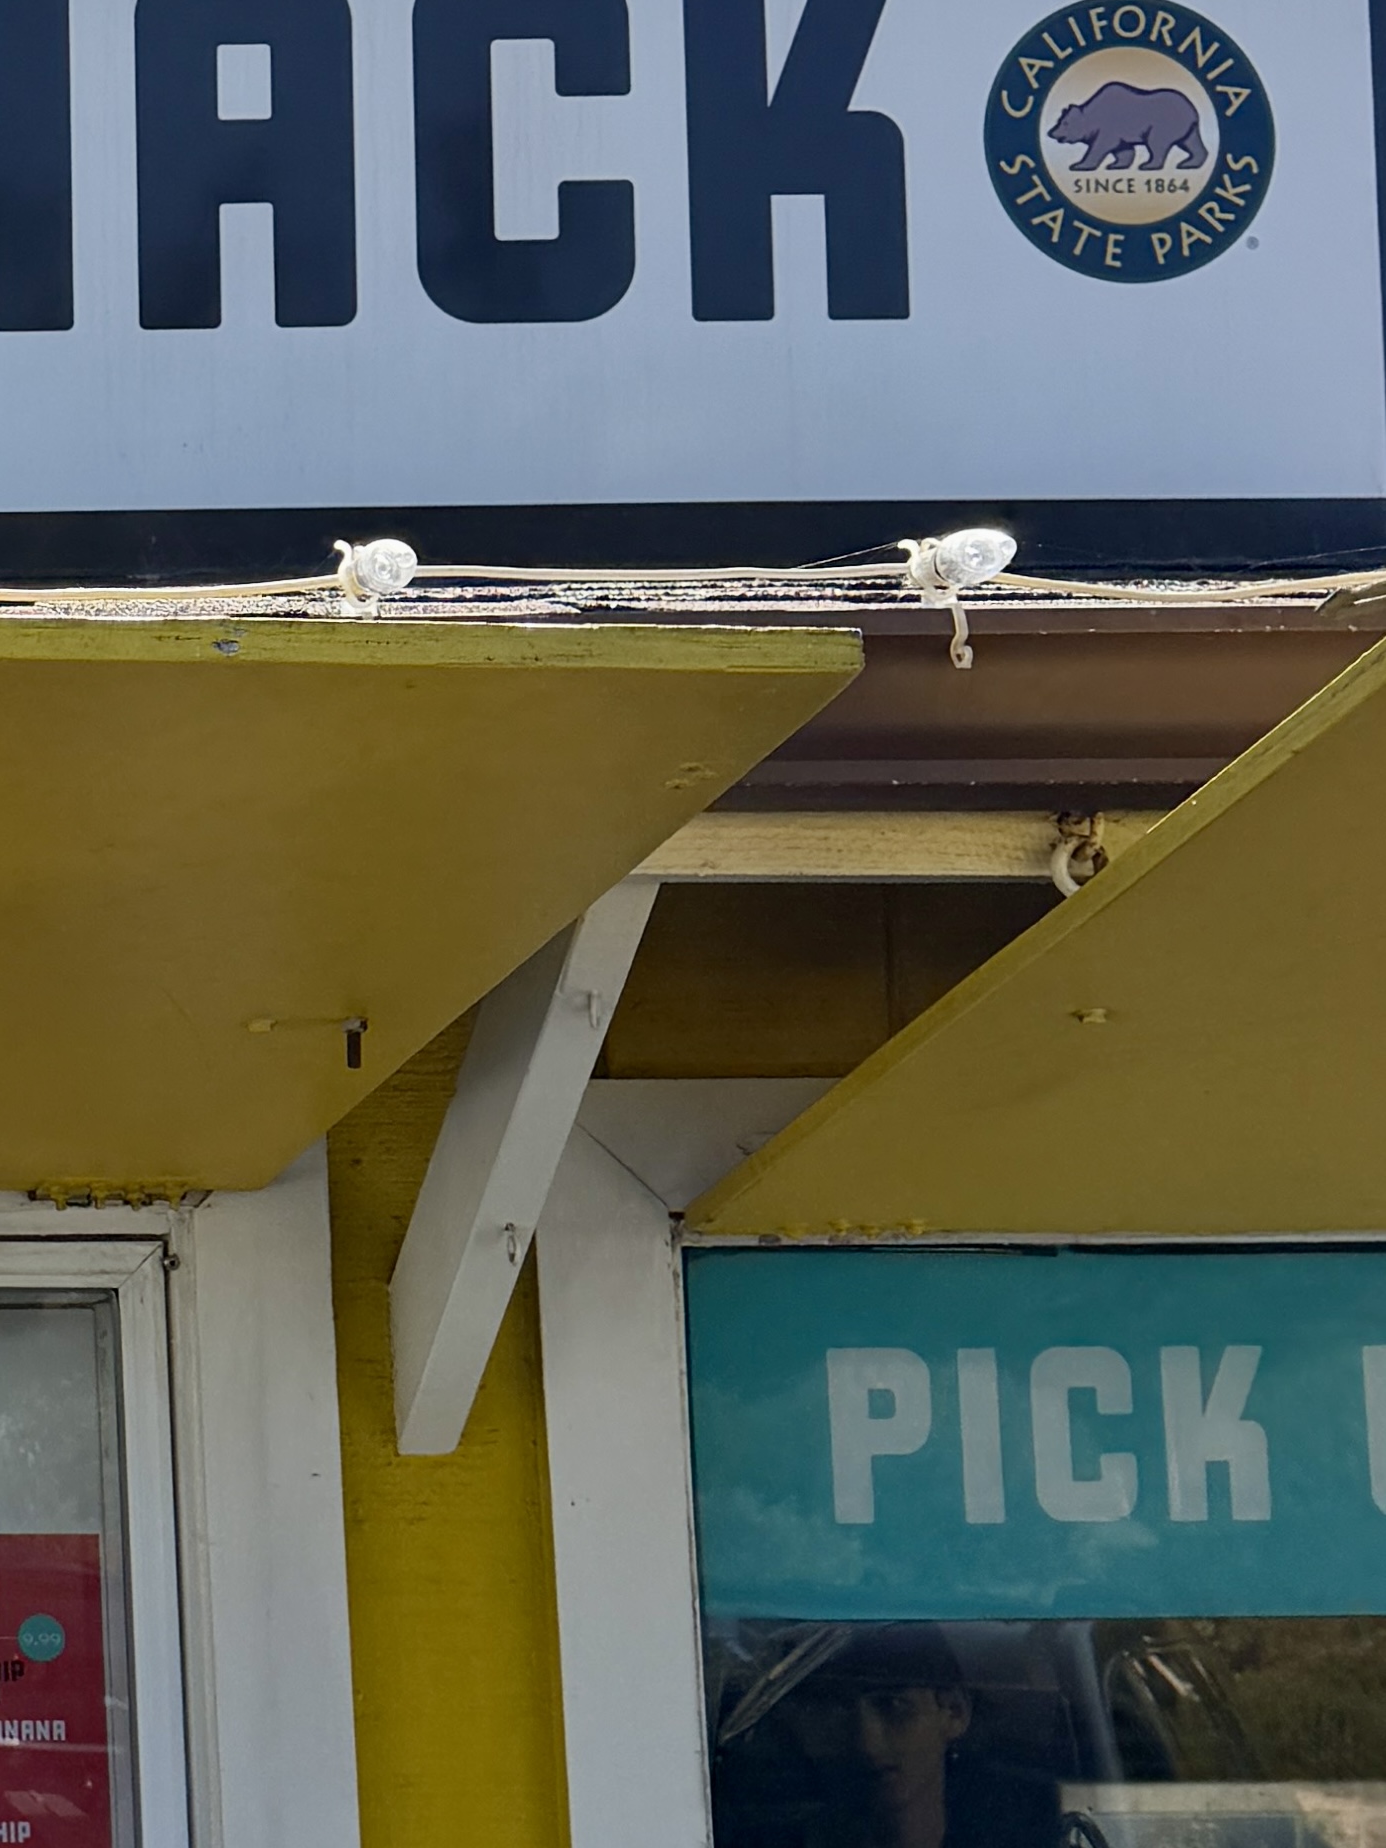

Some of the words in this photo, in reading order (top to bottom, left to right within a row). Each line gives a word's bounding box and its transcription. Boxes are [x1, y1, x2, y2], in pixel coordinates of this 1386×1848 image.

[1001, 5, 1251, 118] CALIFORNIA
[1000, 154, 1125, 268] STATE
[1151, 153, 1259, 264] PARKS
[1074, 178, 1135, 194] SINCE
[1145, 178, 1189, 194] 1864
[827, 1345, 1272, 1524] PICK
